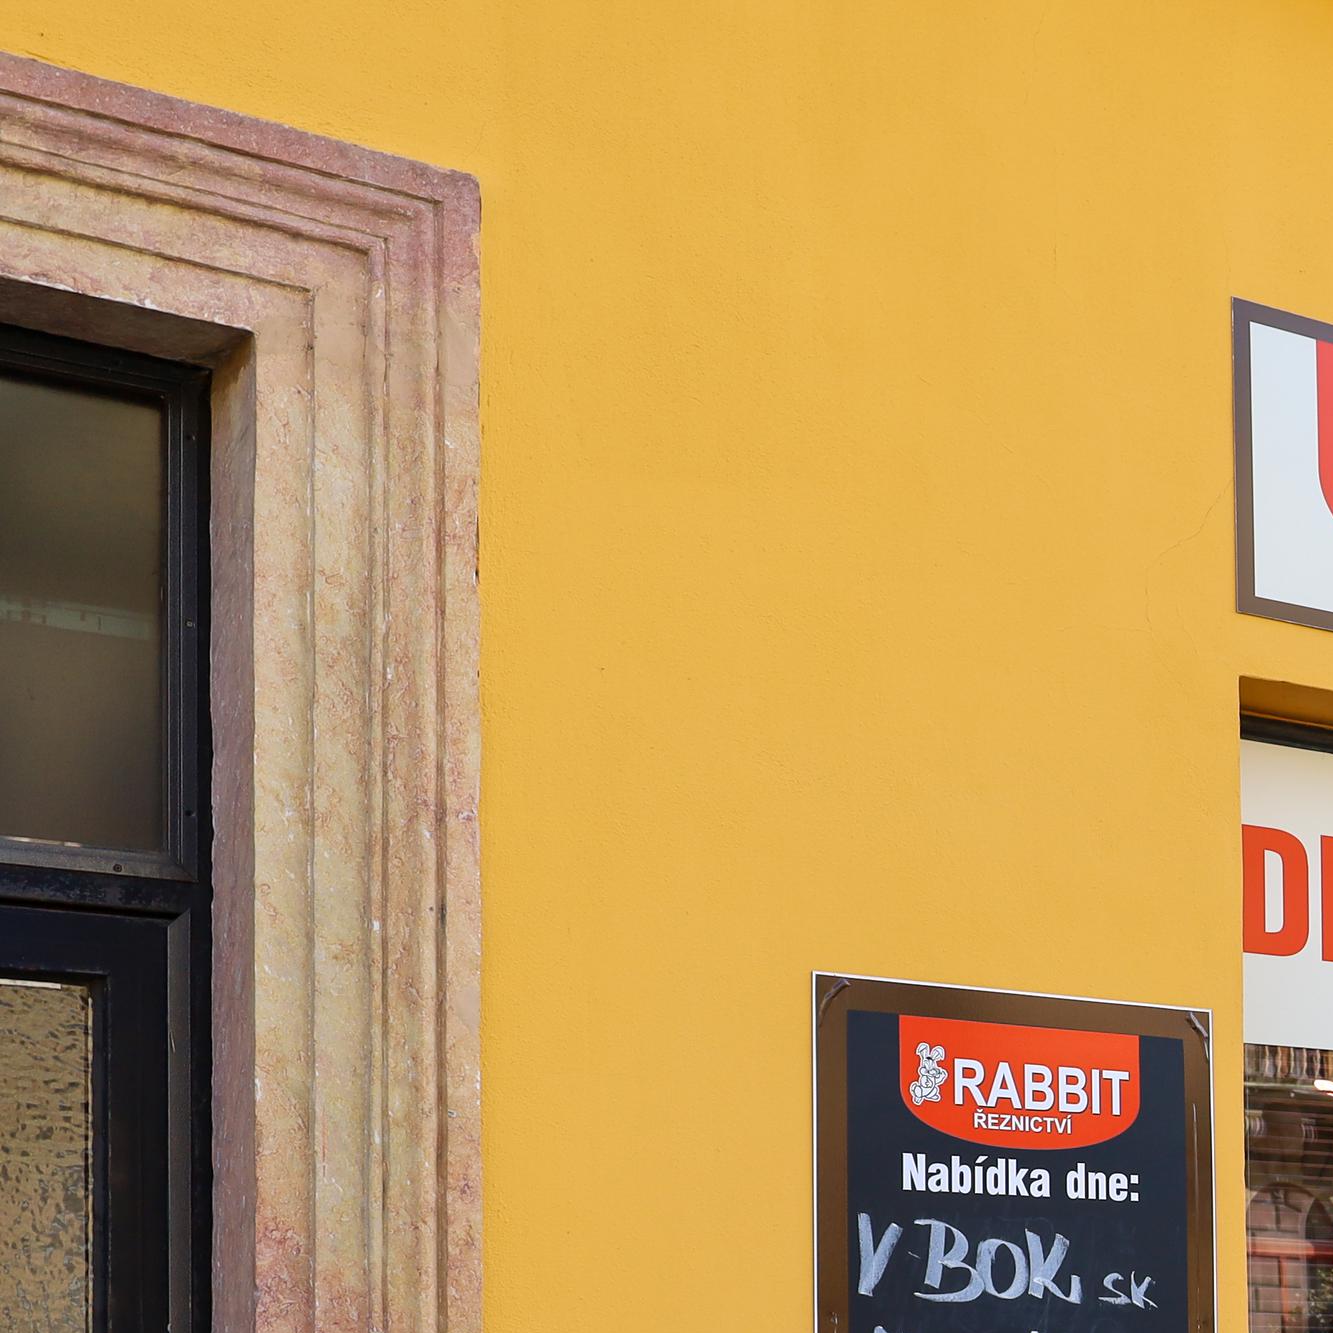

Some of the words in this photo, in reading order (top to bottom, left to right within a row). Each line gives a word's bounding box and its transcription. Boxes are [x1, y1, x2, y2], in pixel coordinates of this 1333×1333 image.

[954, 1058, 1130, 1116] RABBIT
[973, 1109, 1072, 1134] ŘEZNICTVÍ
[902, 1152, 1051, 1198] Nabídka
[1066, 1162, 1140, 1201] dne:
